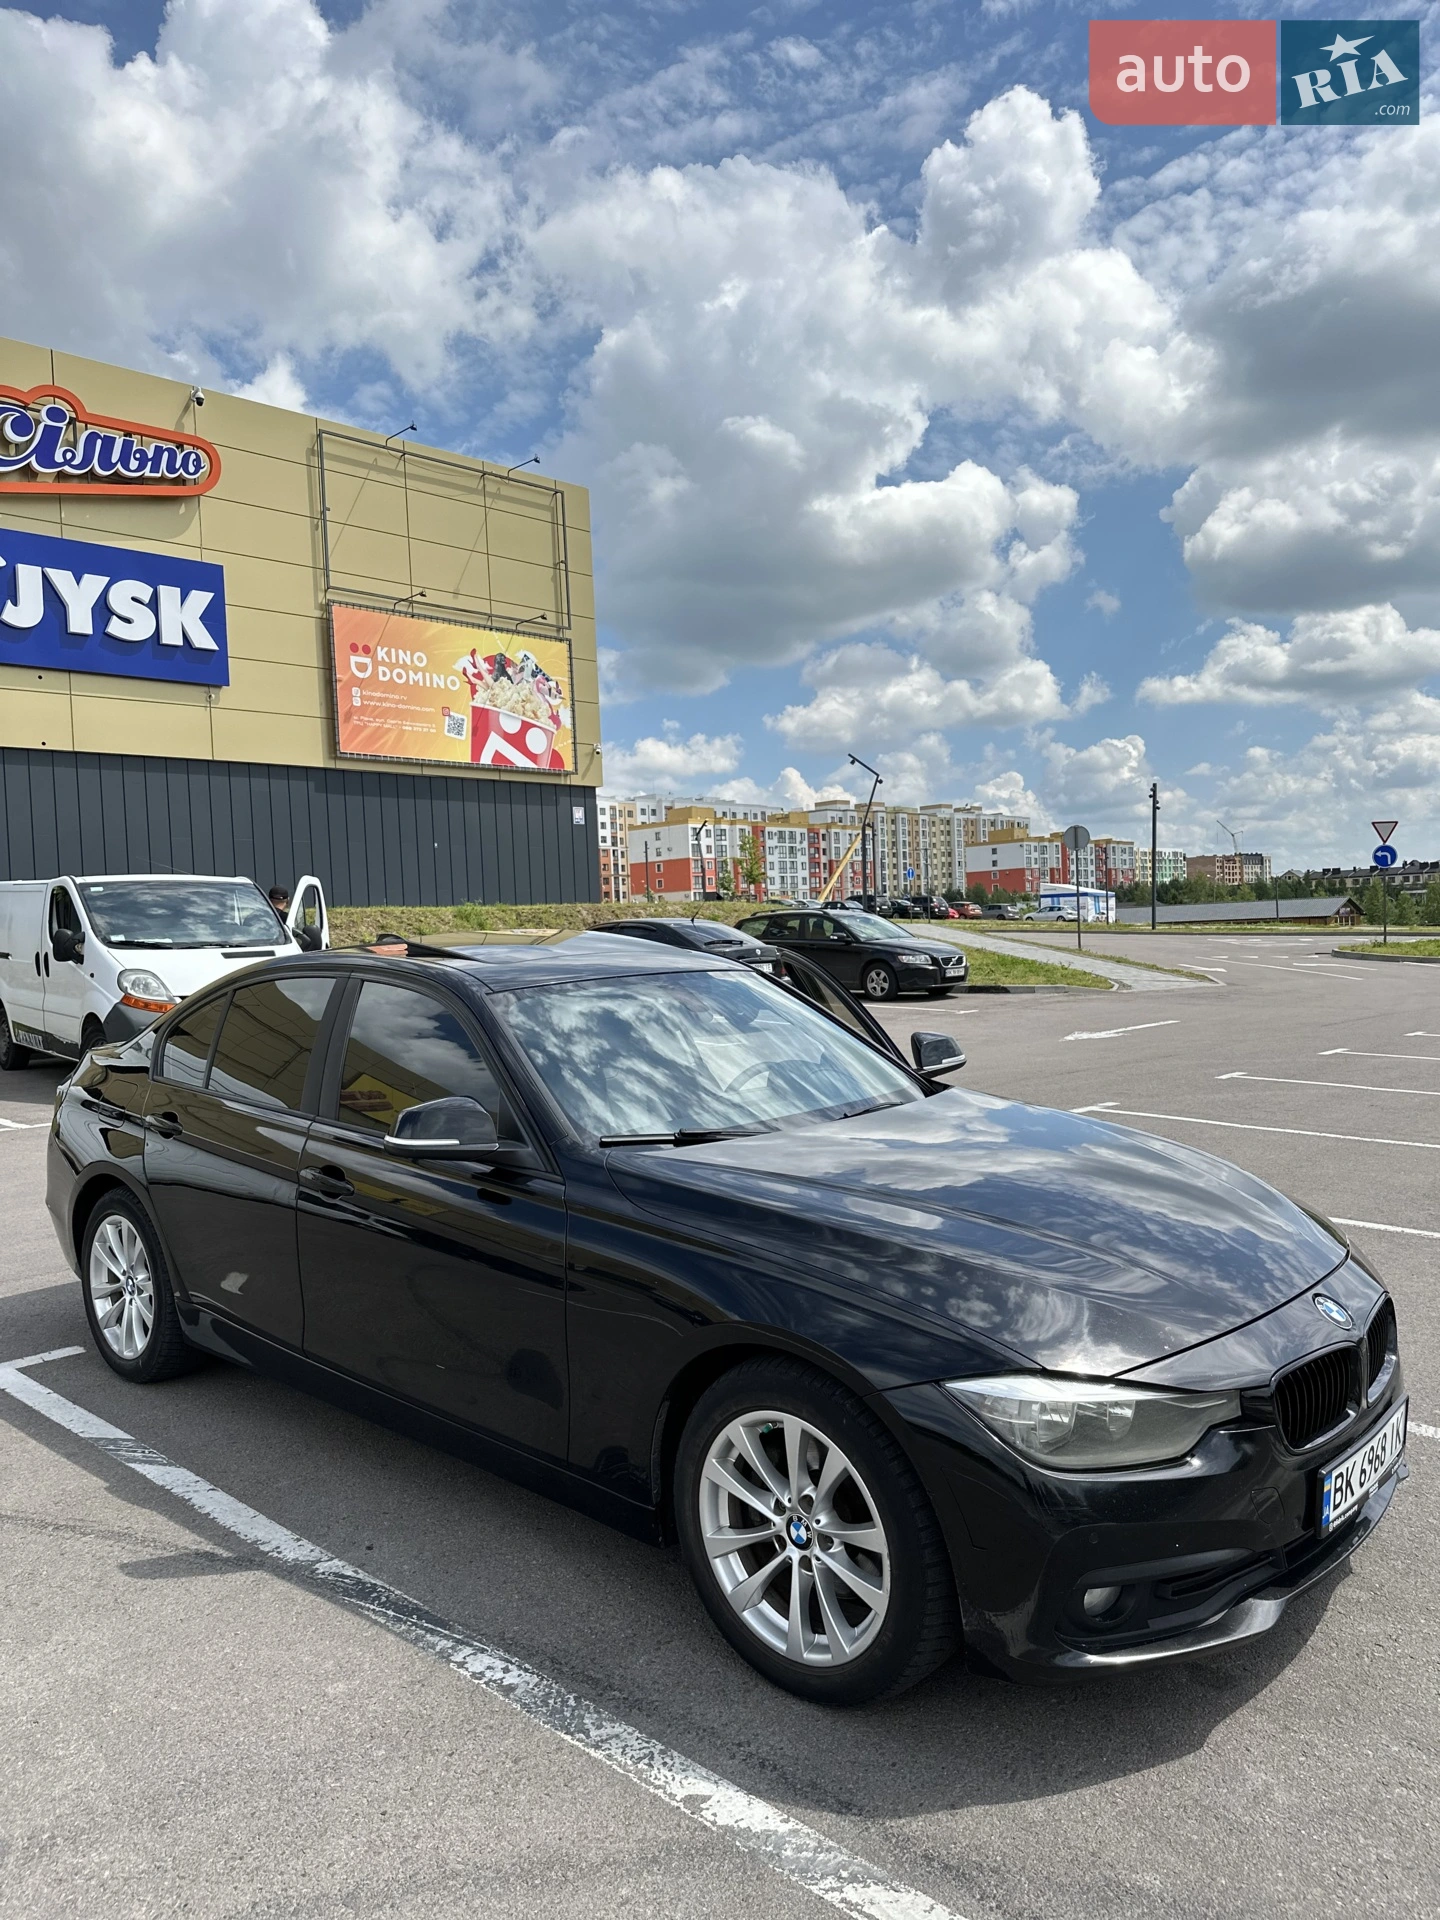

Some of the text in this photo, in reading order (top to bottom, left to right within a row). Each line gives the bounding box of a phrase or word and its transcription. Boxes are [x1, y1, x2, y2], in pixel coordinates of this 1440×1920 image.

[1, 563, 220, 651] JYSK
[377, 645, 428, 667] KINO
[377, 666, 461, 691] DOMINO
[363, 700, 436, 713] www.kino-domino.com
[1359, 1432, 1387, 1489] 6968
[792, 1515, 812, 1539] BMW
